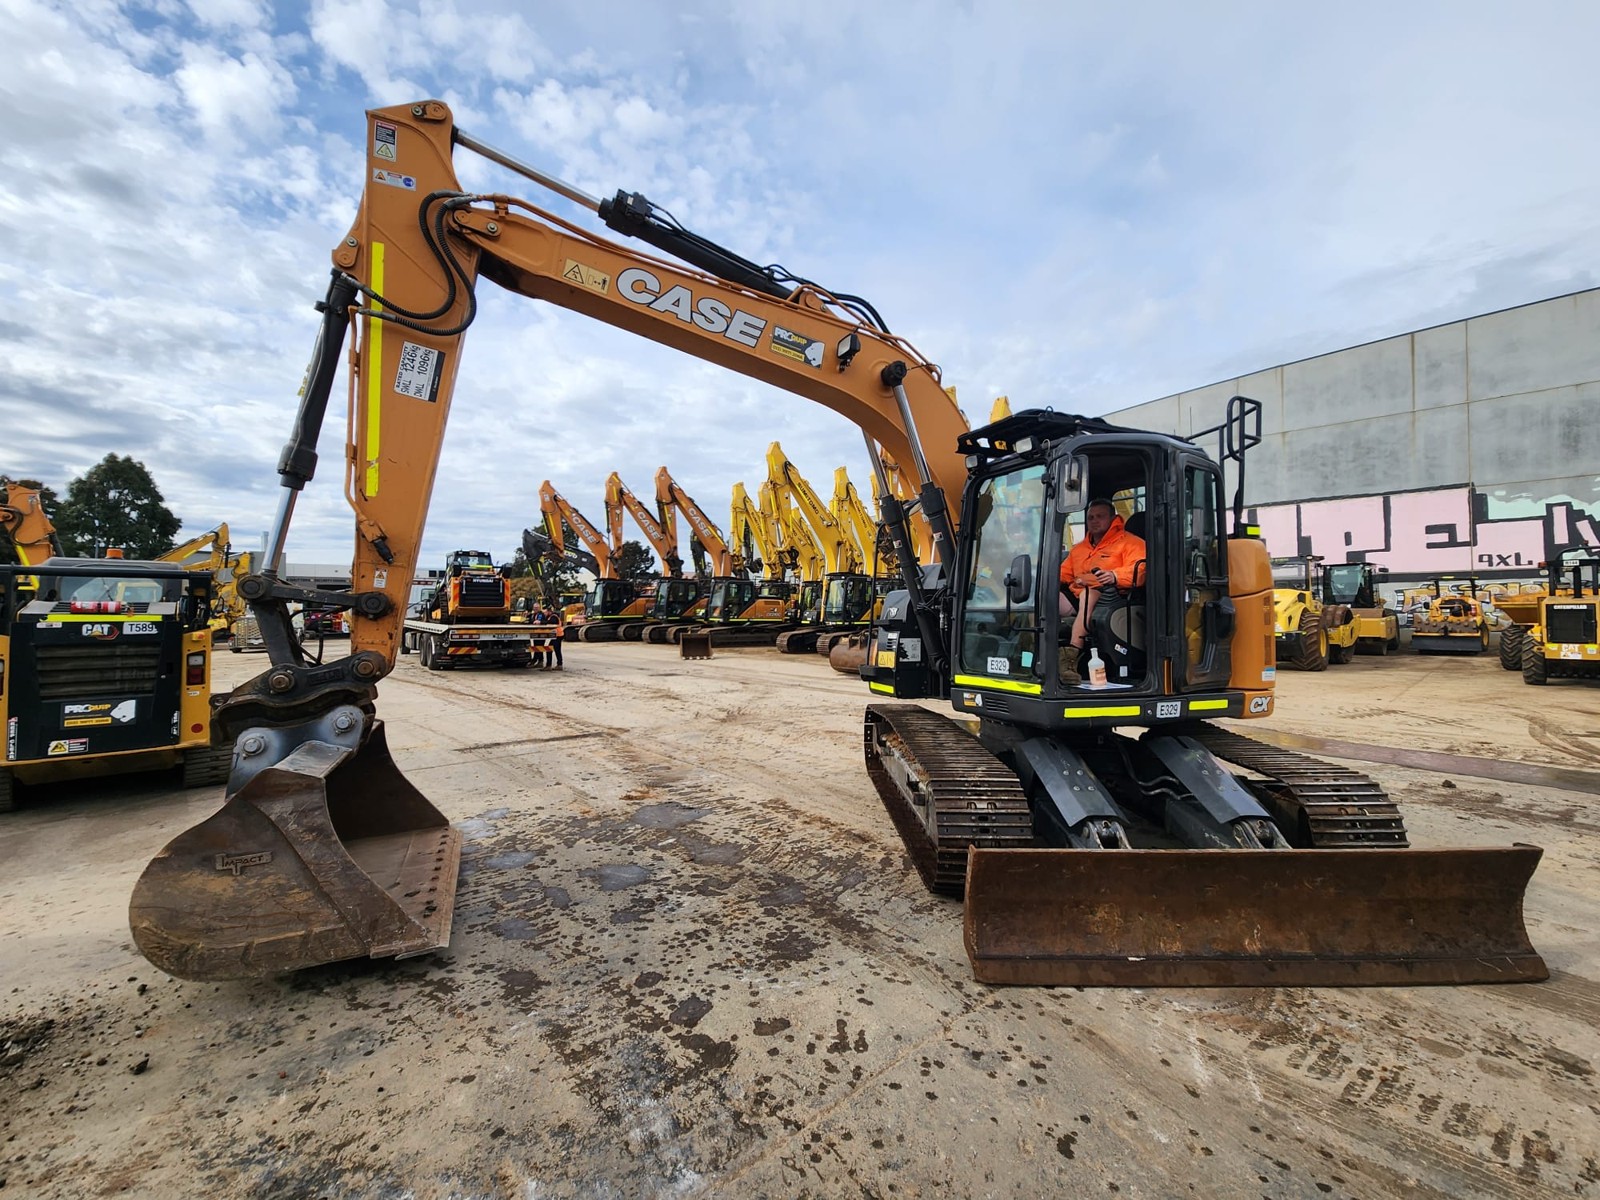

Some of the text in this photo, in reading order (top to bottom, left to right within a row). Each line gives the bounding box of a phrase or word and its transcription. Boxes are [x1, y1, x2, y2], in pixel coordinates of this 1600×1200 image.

[616, 267, 768, 348] CASE
[400, 346, 409, 371] CAPACITY
[572, 515, 596, 544] CASE
[637, 511, 660, 540] CASE
[688, 507, 711, 537] CASE
[82, 624, 111, 636] CAT
[128, 623, 153, 632] T589
[990, 659, 1007, 671] E329
[1160, 704, 1178, 716] E329
[1249, 696, 1272, 713] CX
